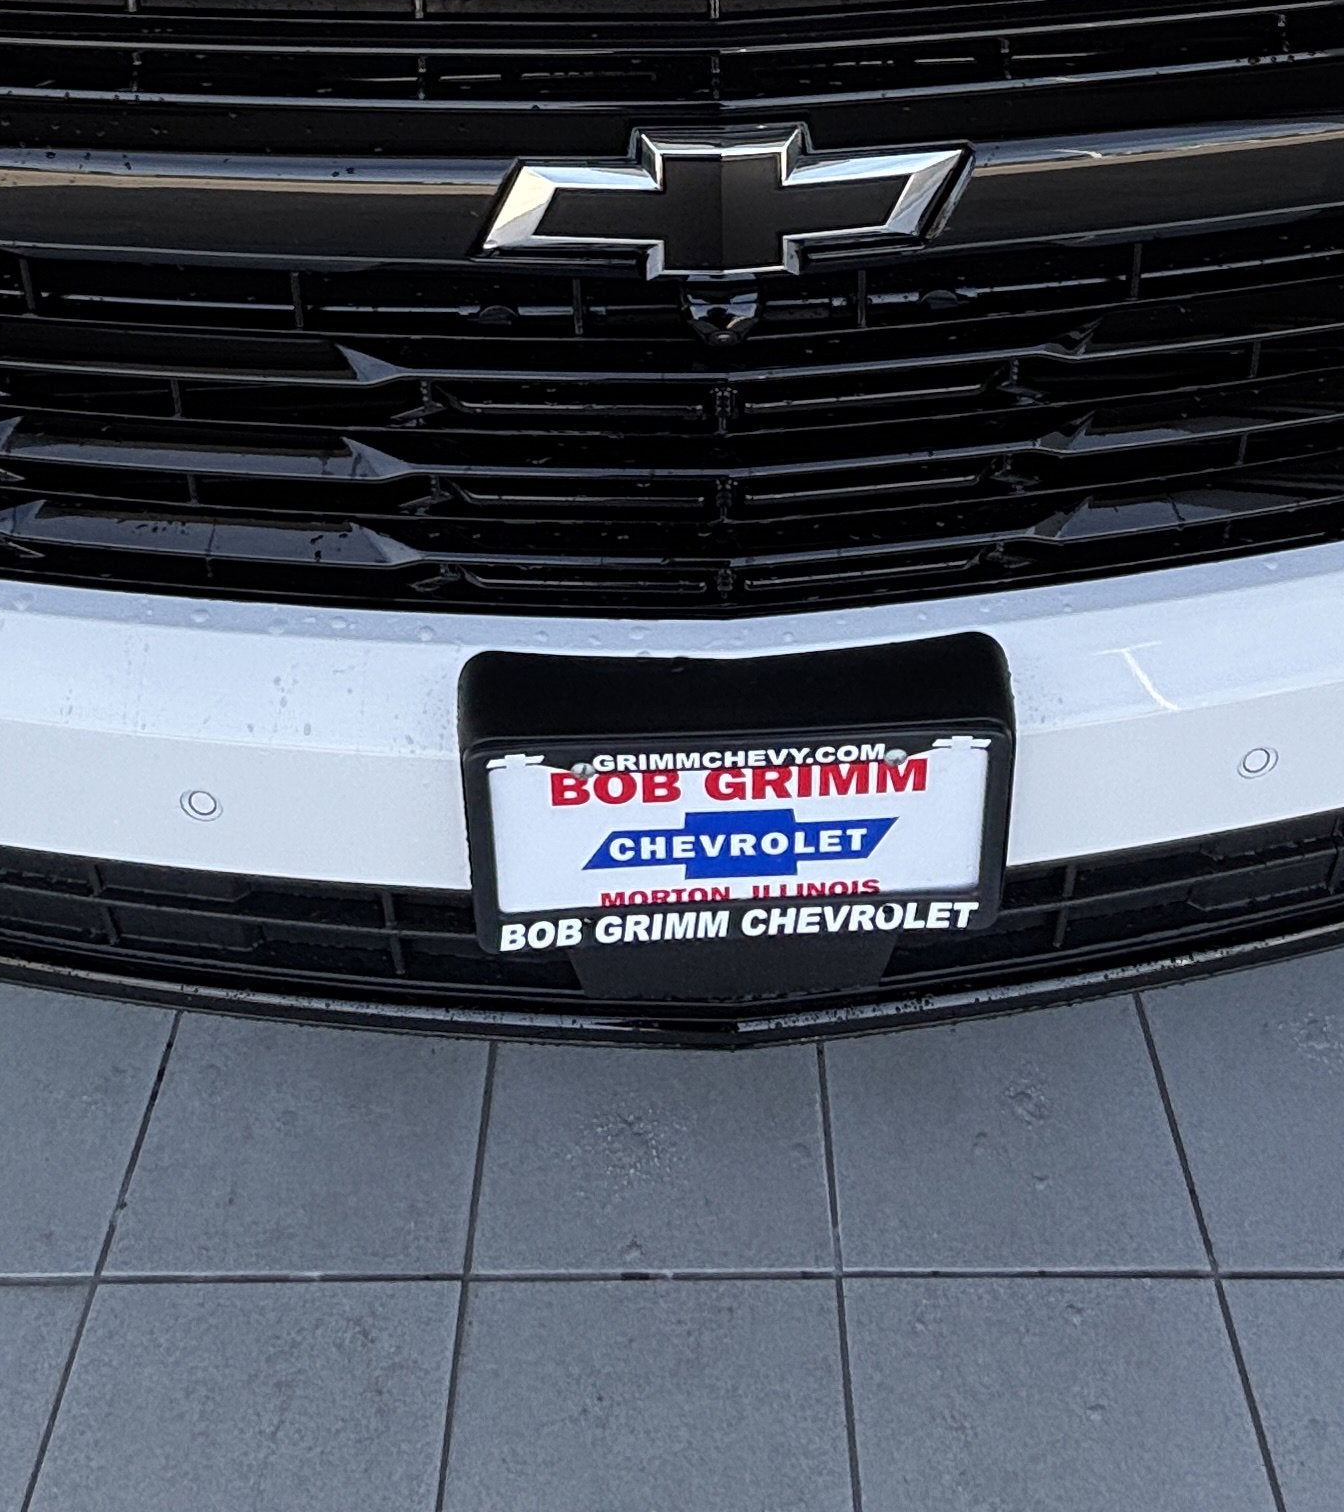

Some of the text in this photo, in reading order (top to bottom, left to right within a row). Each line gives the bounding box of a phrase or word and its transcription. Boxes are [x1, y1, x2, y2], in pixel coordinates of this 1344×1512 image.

[592, 743, 886, 773] GRIMMCHEVY.COM
[549, 757, 929, 807] BOB GRIMM
[609, 827, 868, 862] CHEVROLET
[499, 901, 978, 952] BOB GRIMM CHEVROLET
